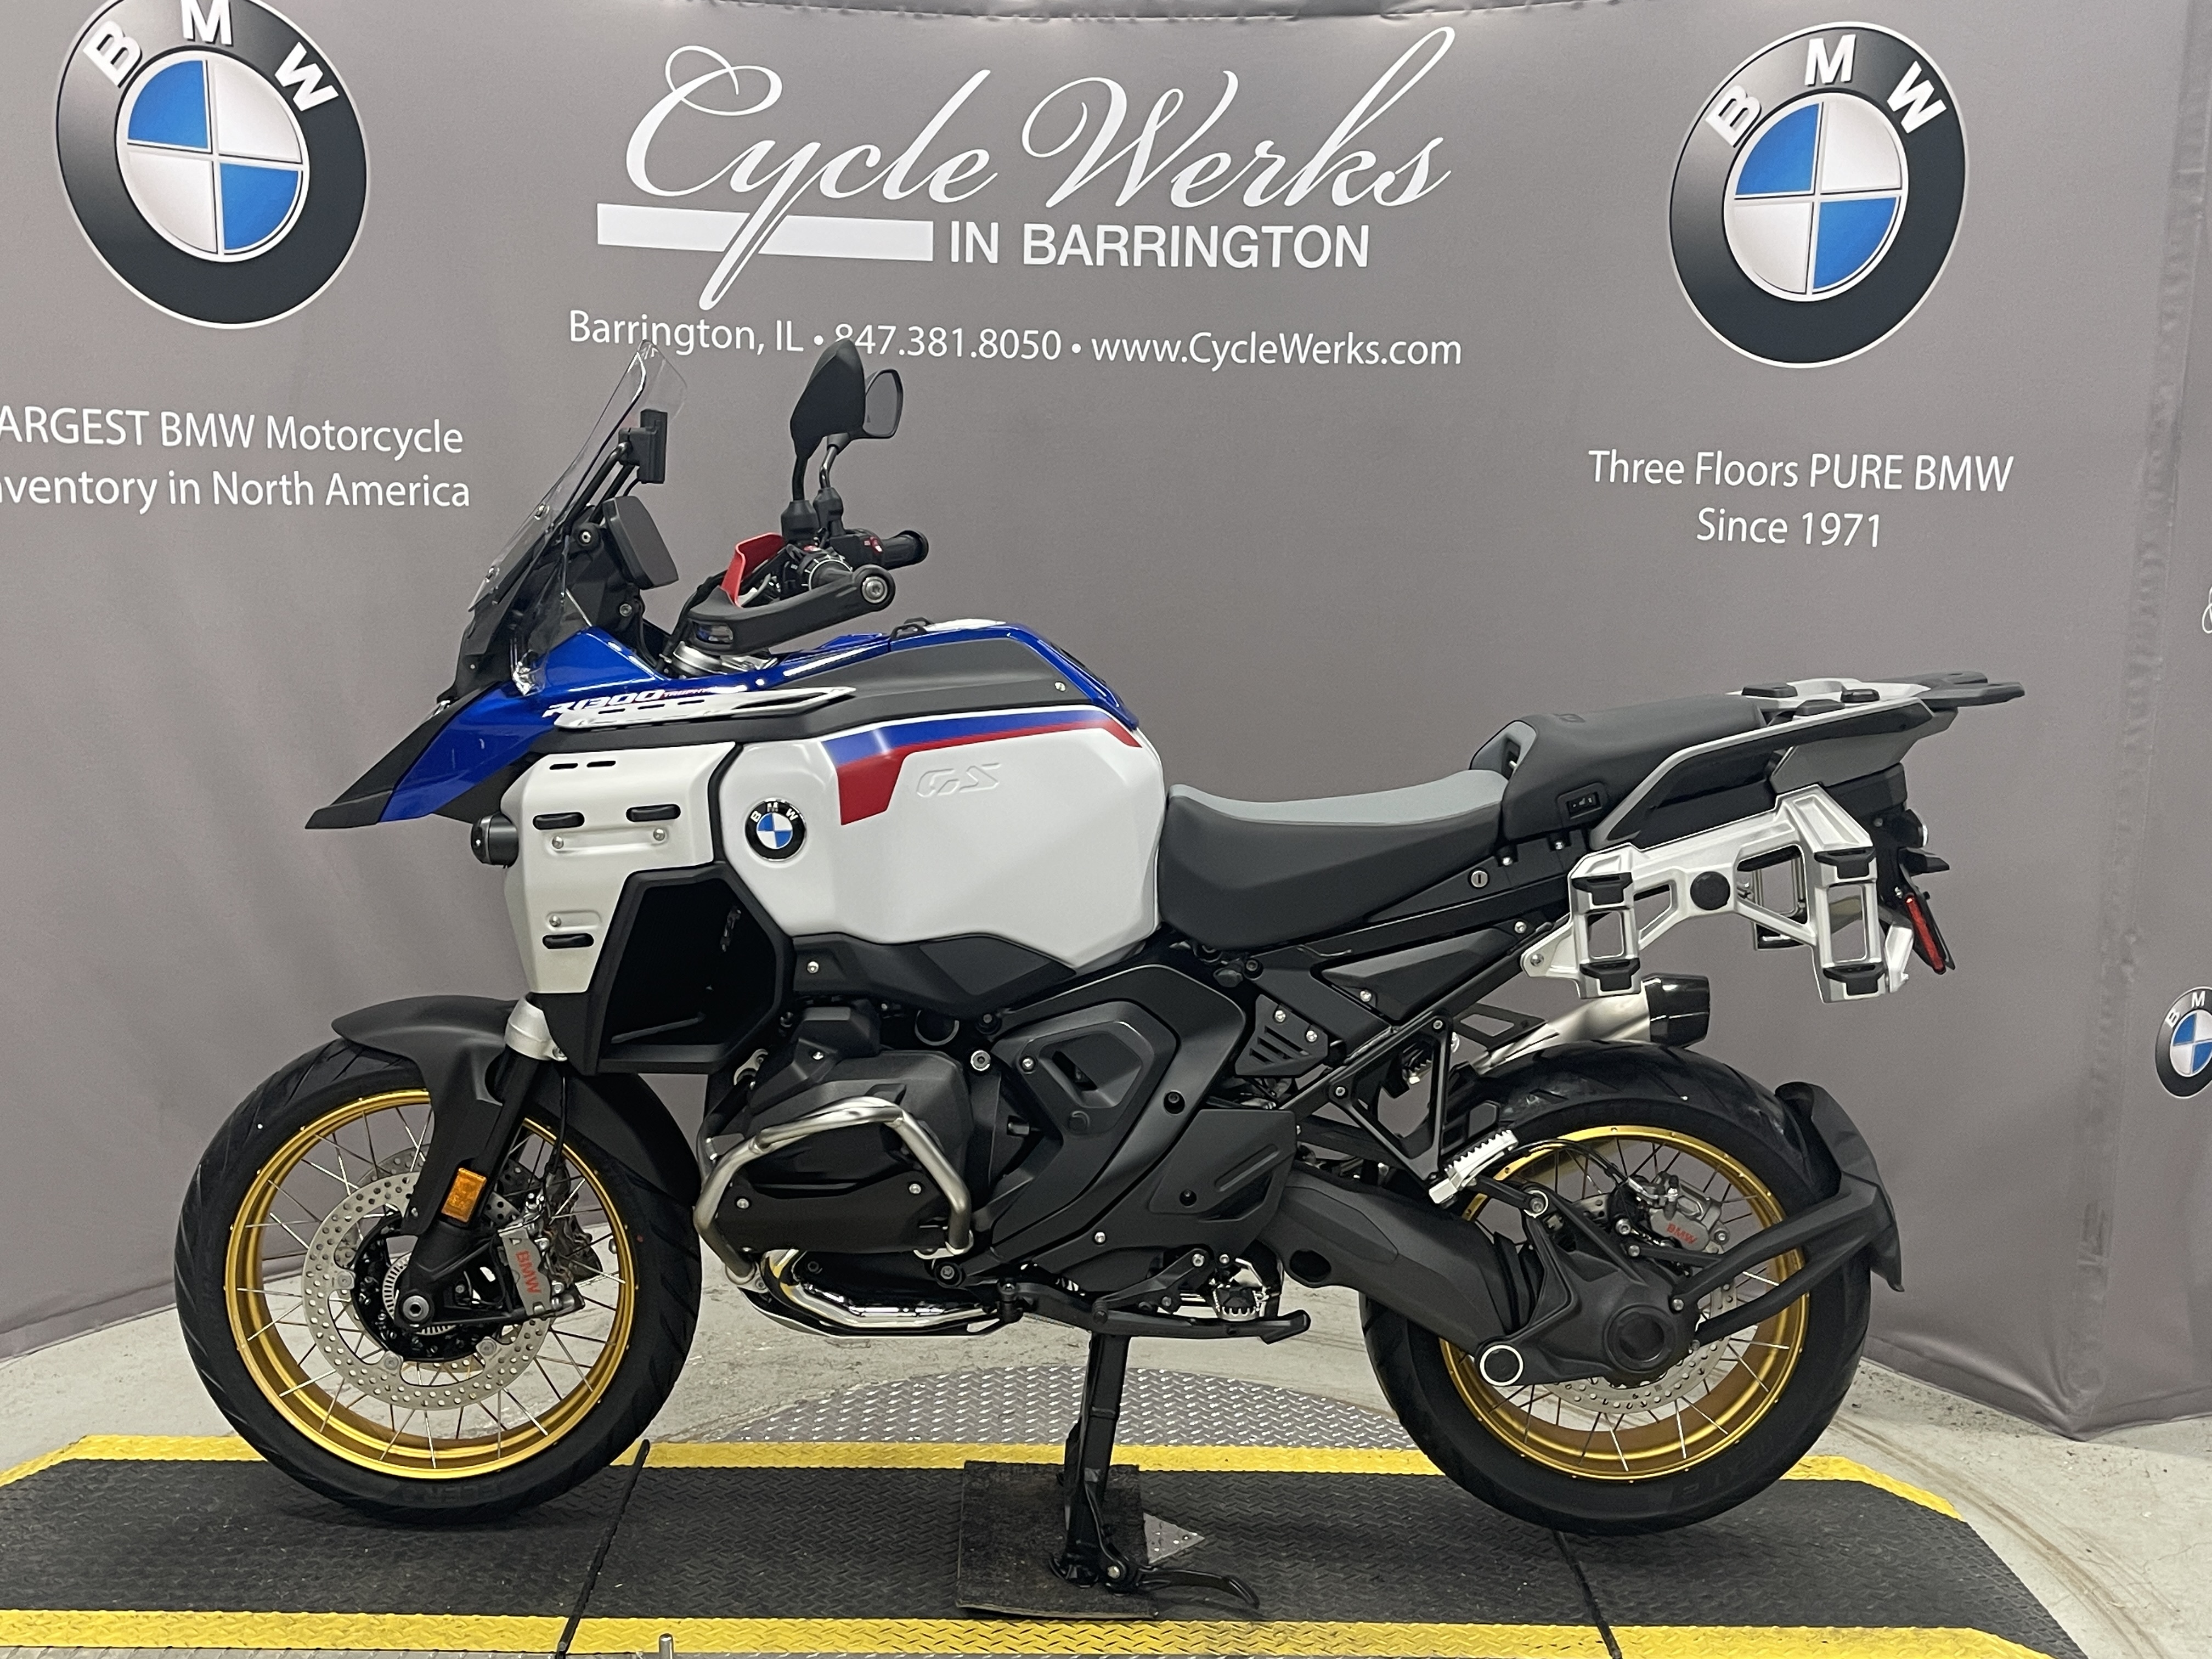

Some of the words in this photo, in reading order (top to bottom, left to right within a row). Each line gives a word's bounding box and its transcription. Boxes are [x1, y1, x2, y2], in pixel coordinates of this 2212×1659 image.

[83, 0, 339, 111] BMW
[1706, 34, 1946, 147] BMW
[626, 46, 998, 311] Cycle
[1022, 26, 1455, 208] Werks
[951, 221, 998, 263] IN
[1023, 223, 1369, 268] BARRINGTON
[570, 310, 764, 356] Barrington,
[777, 320, 804, 352] IL
[1091, 331, 1462, 372] www.CycleWerks.com
[161, 411, 255, 448] BMW
[267, 415, 463, 461] Motorcycle
[0, 471, 157, 515] ventory
[168, 470, 200, 505] in
[213, 470, 314, 505] North
[325, 473, 470, 507] America
[1588, 449, 1684, 484] Three
[1696, 450, 1798, 487] Floors
[1810, 453, 1904, 489] PURE
[1915, 455, 2014, 492] BMW
[1697, 507, 1788, 544] Since
[1802, 512, 1881, 548] 1971
[916, 762, 1002, 798] GS
[750, 802, 799, 822] BMW
[515, 1250, 542, 1294] BMW
